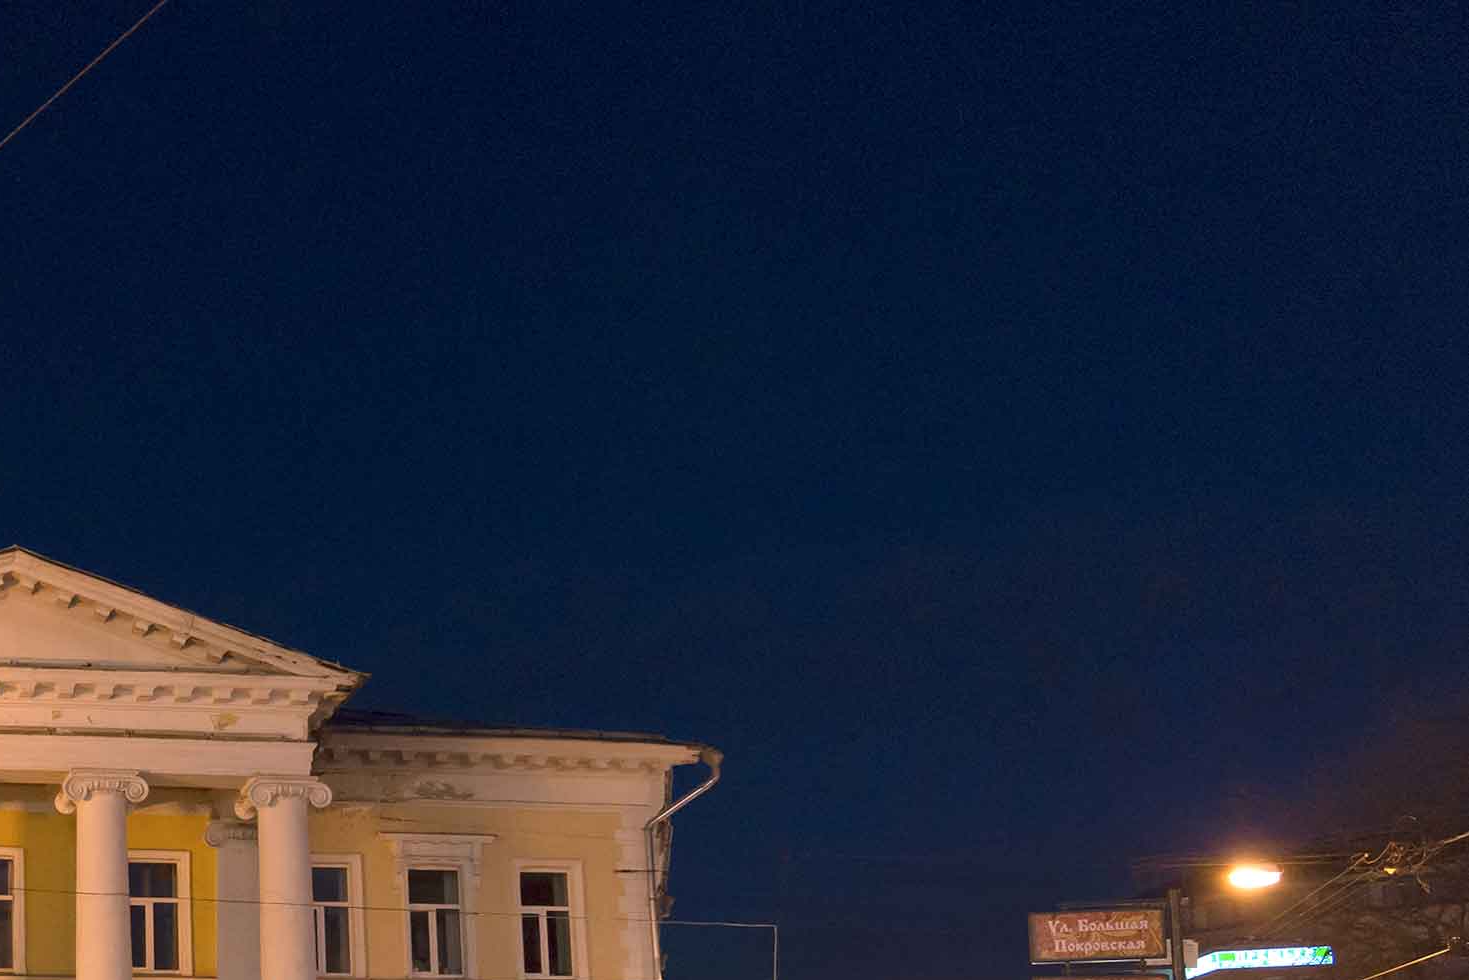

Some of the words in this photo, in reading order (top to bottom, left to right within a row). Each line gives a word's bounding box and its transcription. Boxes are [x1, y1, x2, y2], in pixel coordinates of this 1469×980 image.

[1047, 920, 1072, 937] Ул.
[1077, 919, 1149, 933] Большая
[1054, 940, 1146, 956] Покровская
